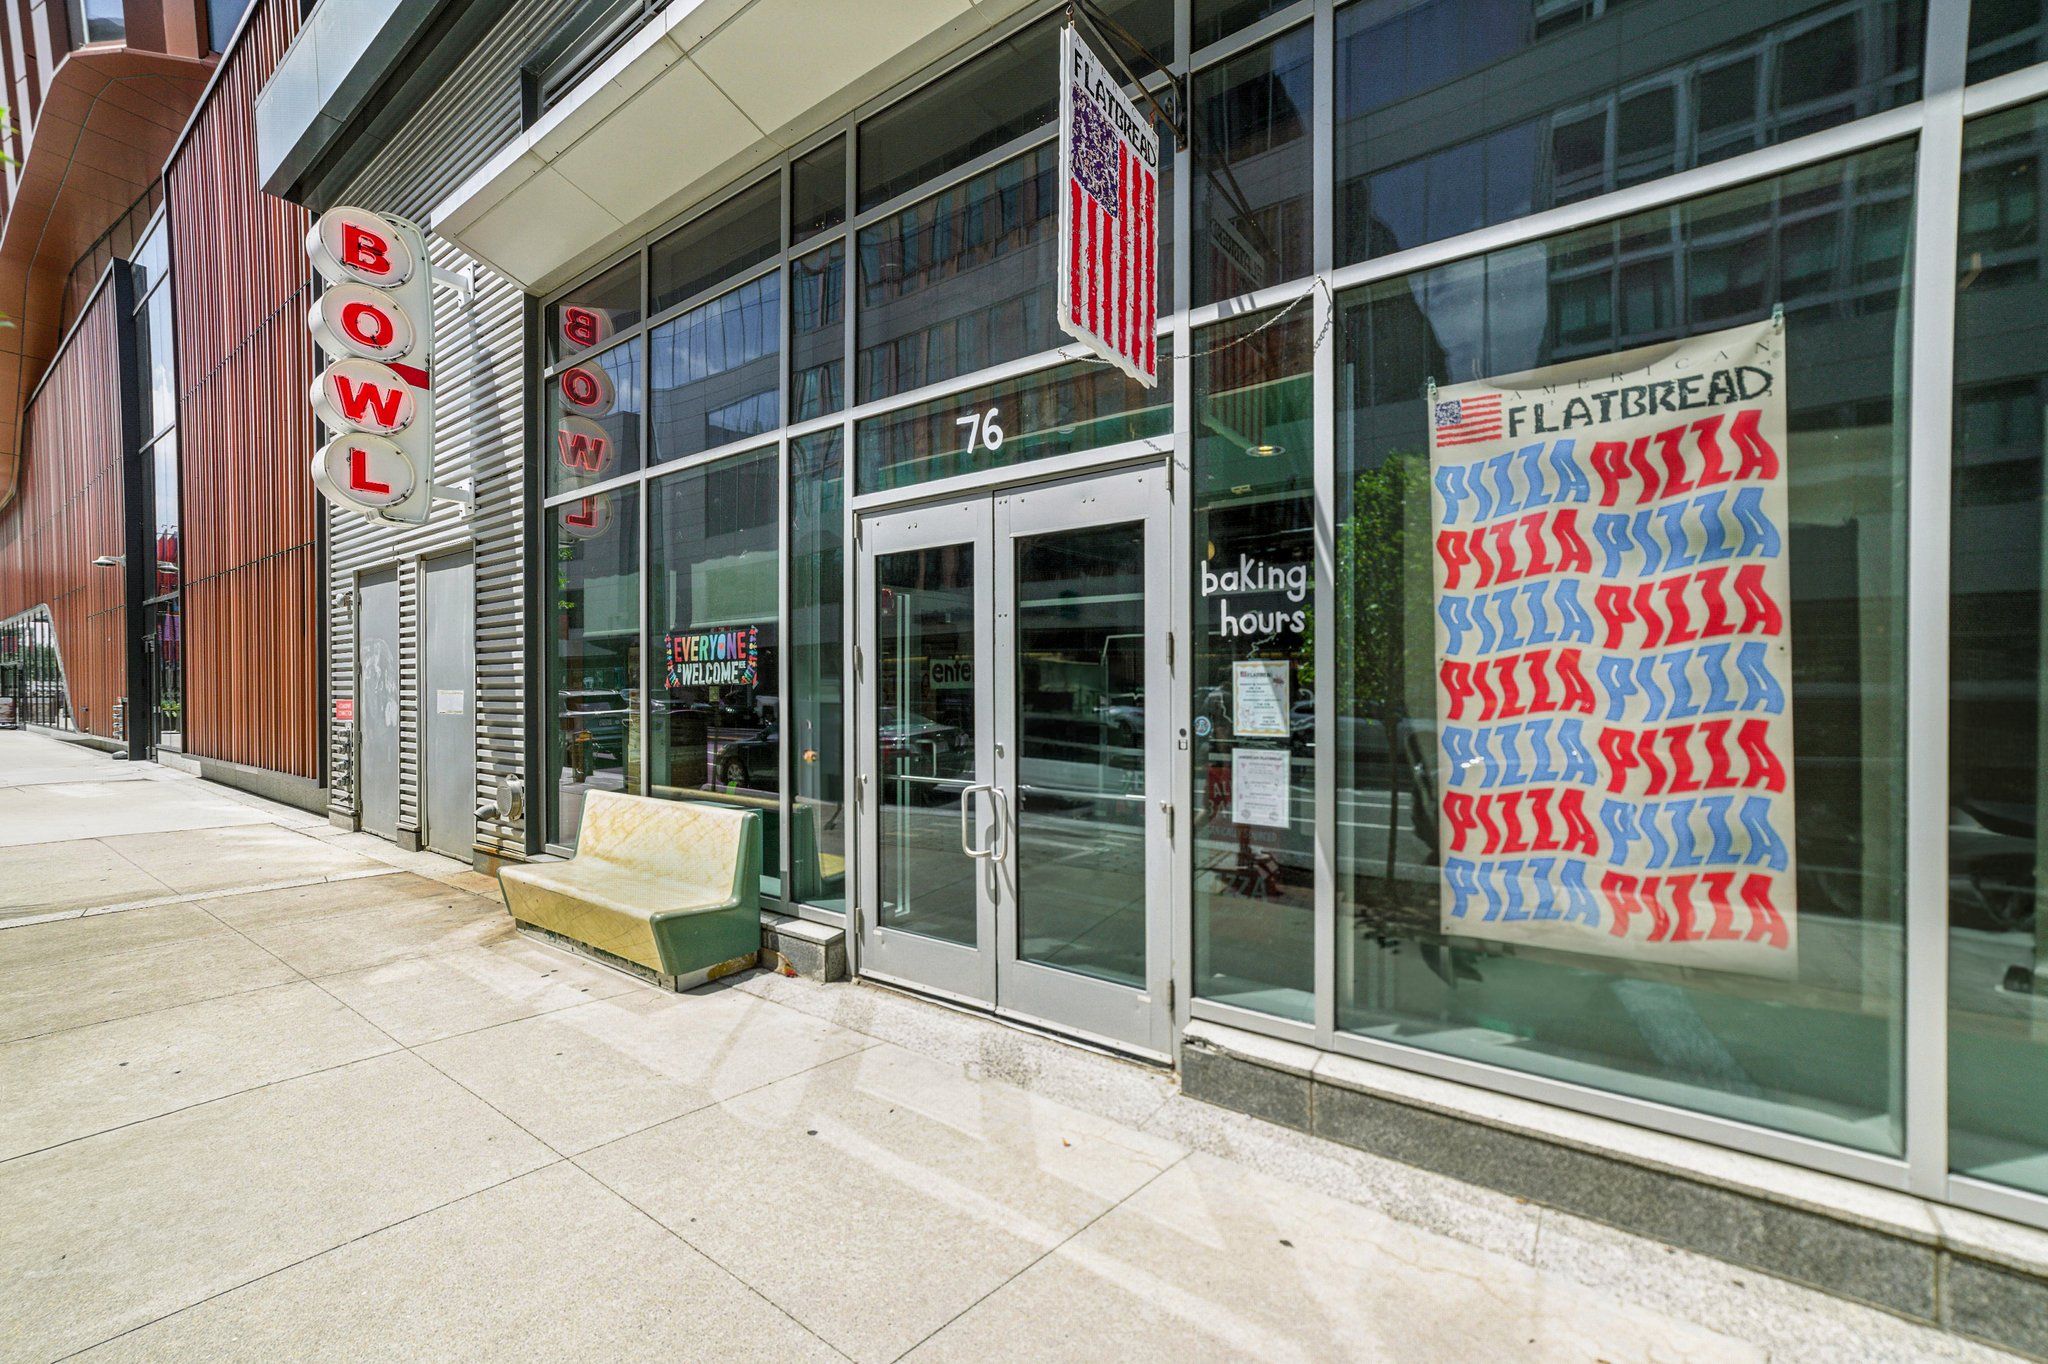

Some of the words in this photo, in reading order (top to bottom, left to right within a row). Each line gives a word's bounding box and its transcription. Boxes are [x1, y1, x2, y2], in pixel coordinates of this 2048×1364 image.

[1074, 47, 1157, 168] FLATBREAD
[333, 221, 404, 496] BOWL
[956, 407, 1004, 454] 76
[1508, 365, 1774, 438] FLATBREAD
[1435, 439, 1592, 526] PIZZA
[1590, 410, 1781, 508] PIZZA
[1200, 553, 1307, 602] baking
[1436, 509, 1595, 592] PIZZA
[1592, 487, 1784, 580] PIZZA
[674, 631, 747, 662] EVERYONE
[1220, 598, 1306, 637] hours
[1438, 579, 1596, 657] PIZZA
[1594, 565, 1785, 651] PIZZA
[682, 660, 739, 686] WELCOME
[1440, 648, 1598, 723] PIZZA
[1597, 642, 1787, 724] PIZZA
[1442, 719, 1600, 789] PIZZA
[1598, 718, 1789, 798] PIZZA
[1443, 788, 1601, 858] PIZZA
[1600, 796, 1791, 872] PIZZA
[1445, 858, 1601, 926] PIZZA
[1601, 871, 1790, 949] PIZZA
